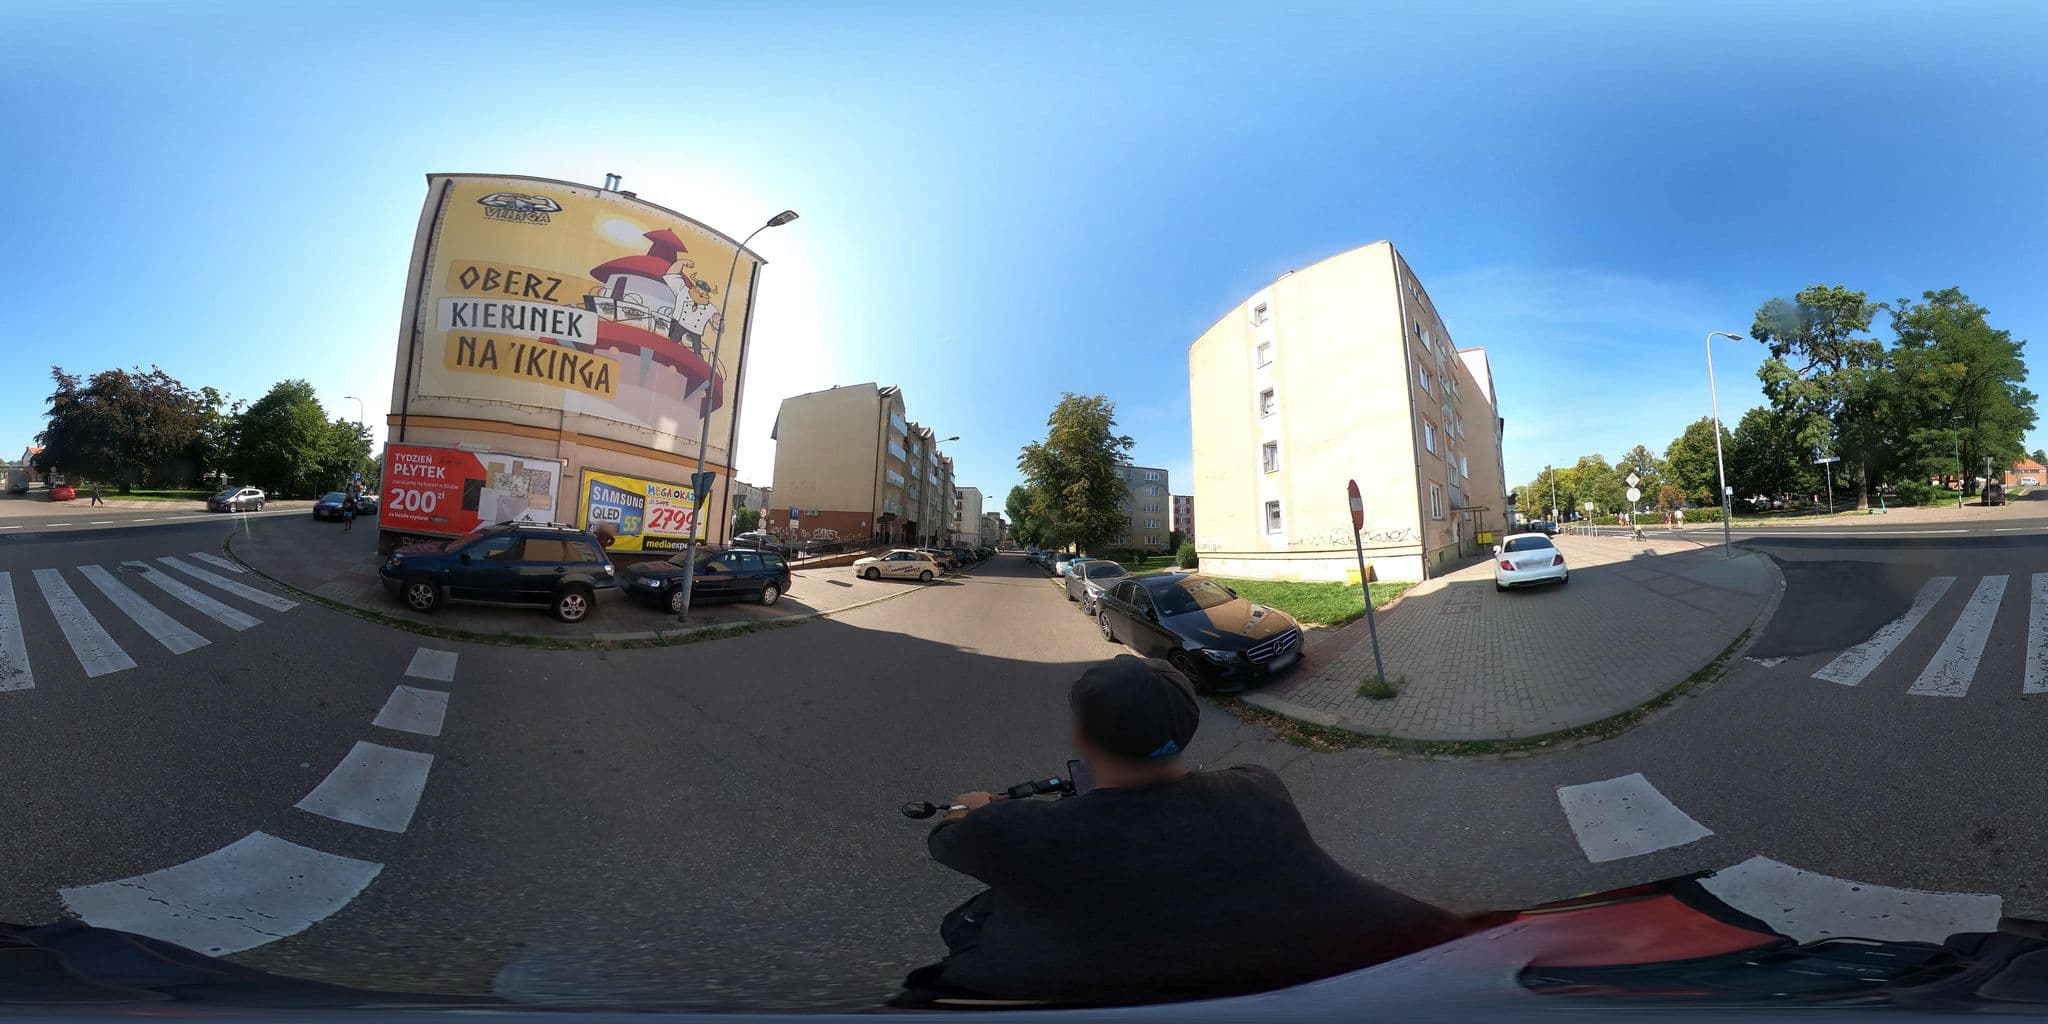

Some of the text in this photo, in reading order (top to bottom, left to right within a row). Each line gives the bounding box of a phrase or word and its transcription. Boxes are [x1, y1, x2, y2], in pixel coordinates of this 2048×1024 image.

[459, 266, 562, 303] OBERZ
[456, 336, 610, 393] NA IKINGA
[394, 453, 432, 463] TYDZIEŃ
[394, 464, 446, 479] PŁYTEK
[390, 488, 436, 513] 200
[592, 486, 644, 509] SAMSUNG
[648, 485, 672, 498] MEGA
[673, 490, 696, 502] OKAZ
[592, 506, 620, 520] QLED
[646, 539, 689, 551] mediaexpe
